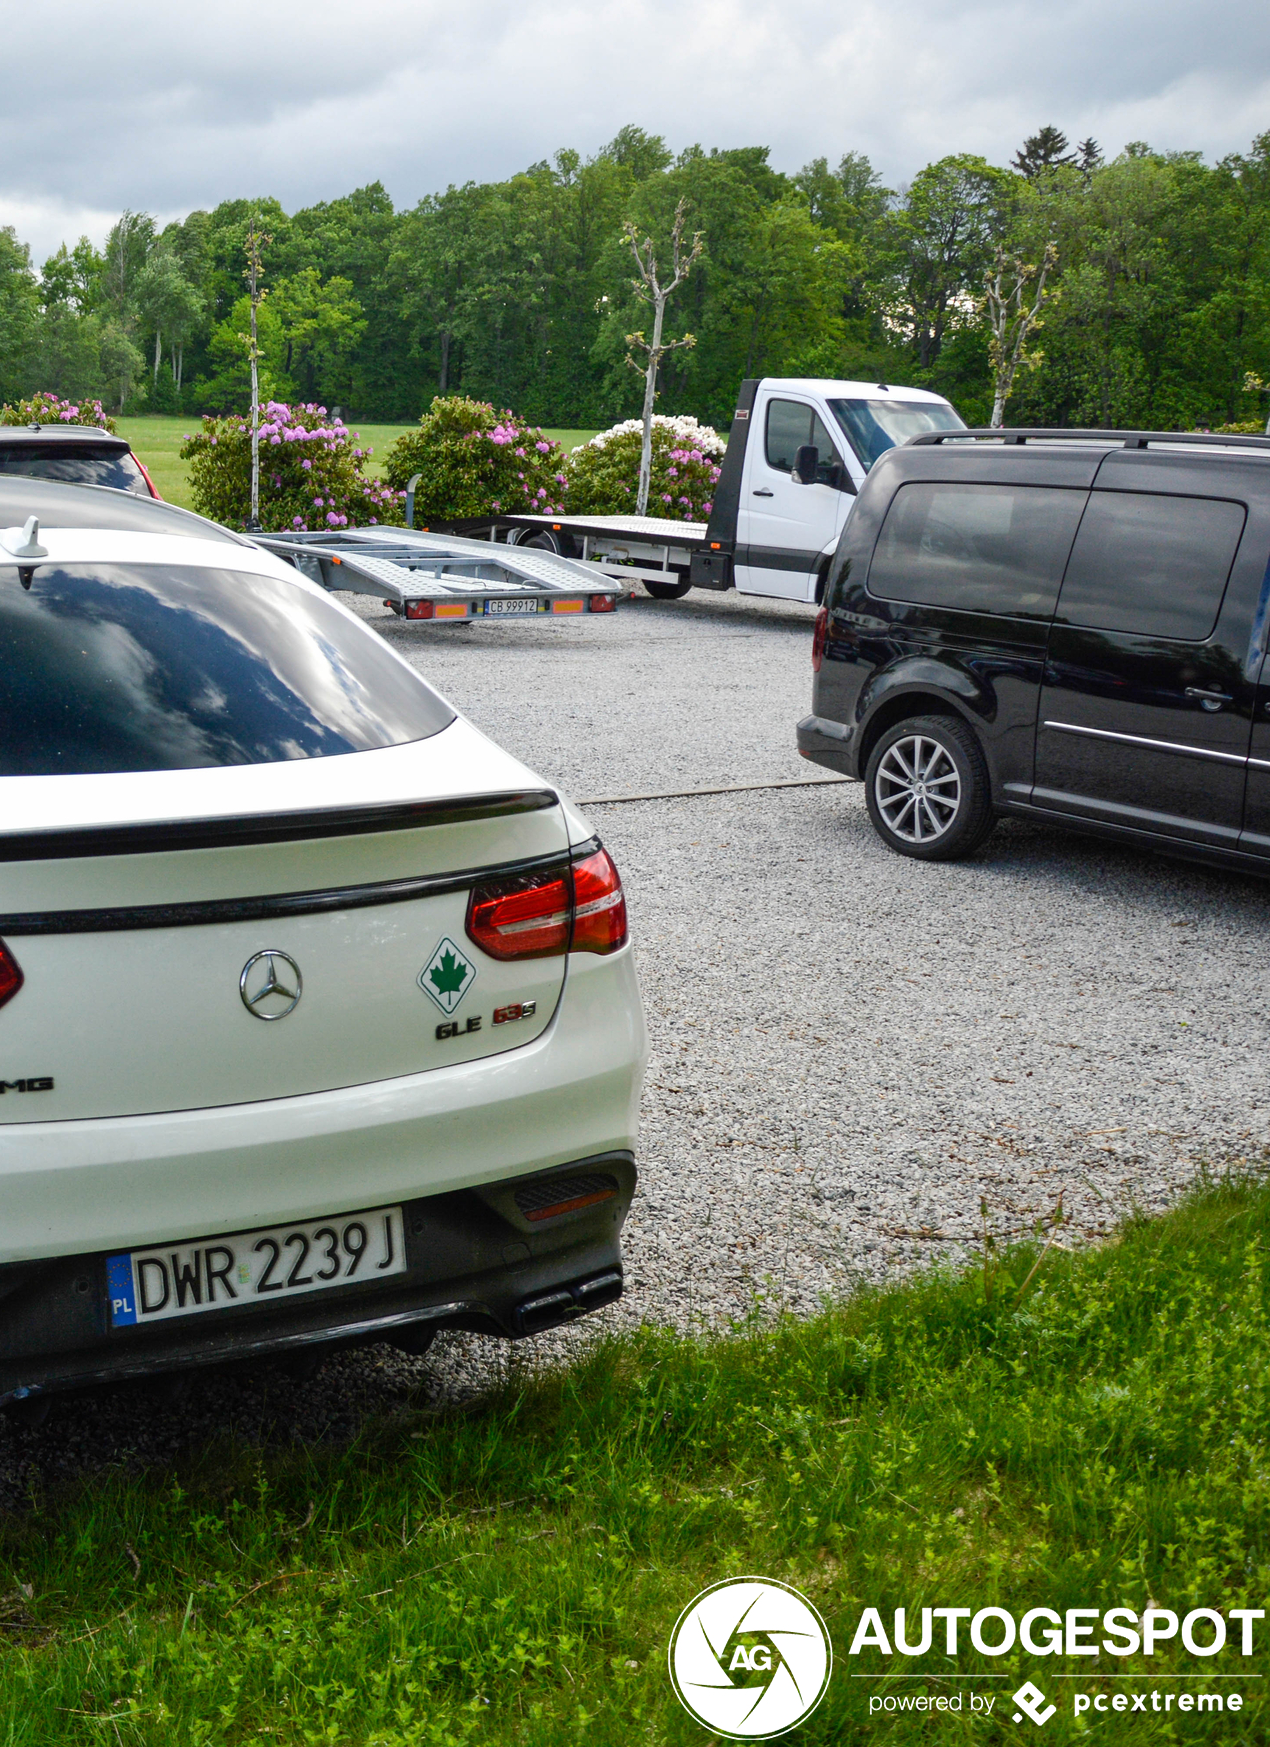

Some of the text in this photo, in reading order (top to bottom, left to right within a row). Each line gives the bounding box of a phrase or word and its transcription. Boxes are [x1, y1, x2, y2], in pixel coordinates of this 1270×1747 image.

[491, 600, 535, 613] CB 99912
[435, 1015, 482, 1040] GLE
[136, 1245, 237, 1315] DWR
[113, 1297, 132, 1315] PL
